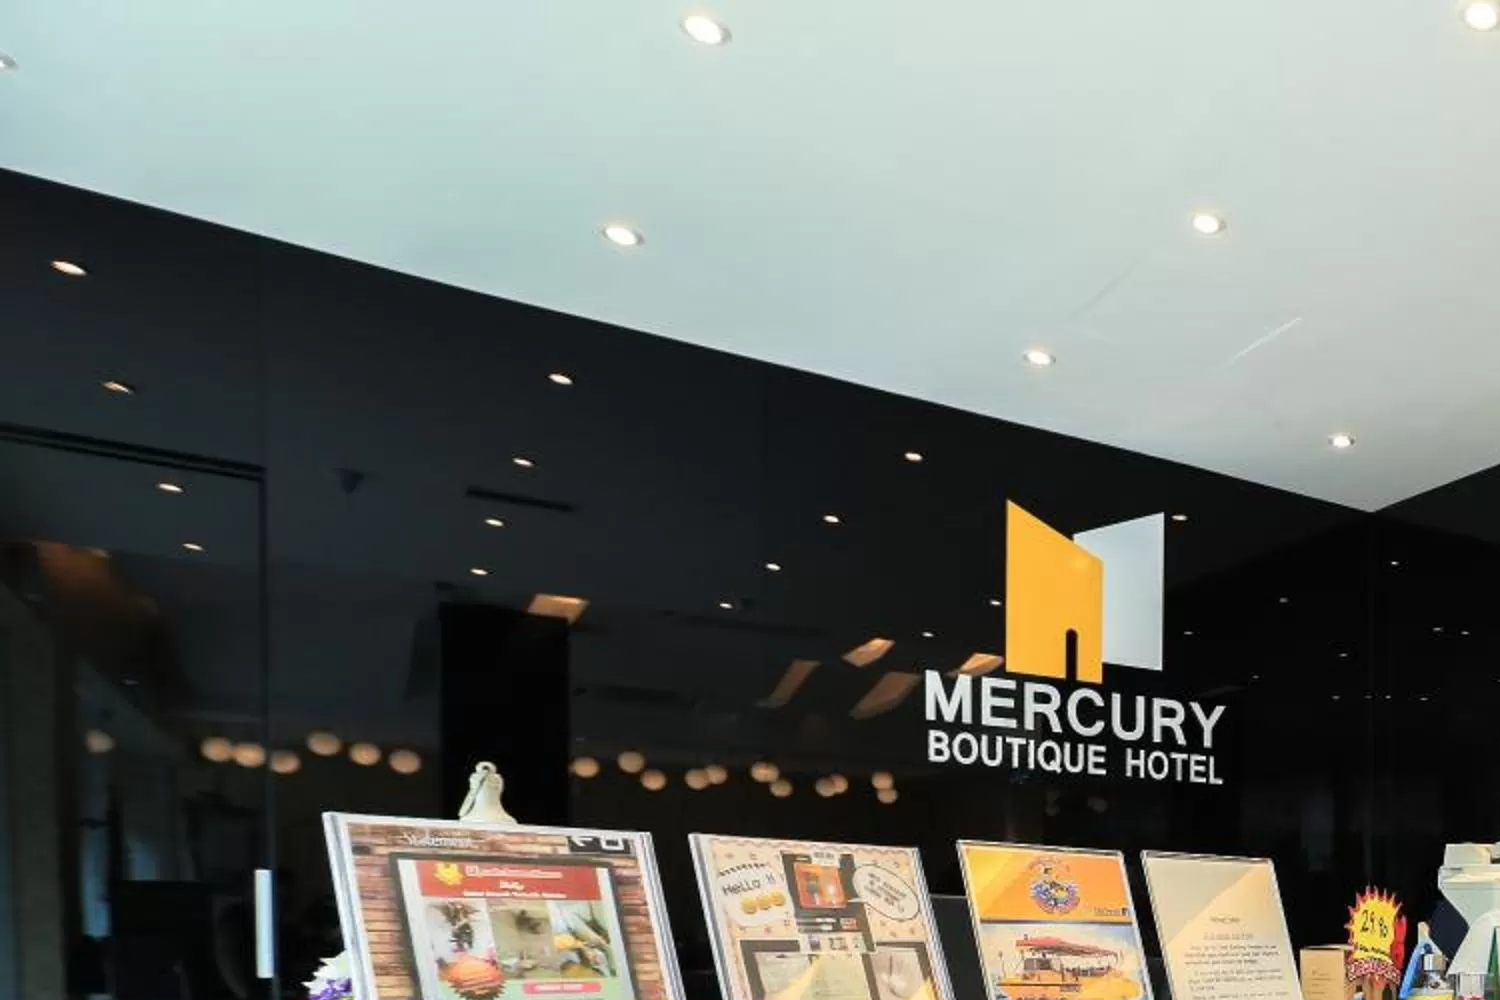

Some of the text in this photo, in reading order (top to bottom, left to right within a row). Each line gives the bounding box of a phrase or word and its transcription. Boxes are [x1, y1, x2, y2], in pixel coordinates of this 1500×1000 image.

[925, 669, 1226, 749] MERCURY
[927, 730, 1224, 785] BOUTIQUE HOTEL
[721, 879, 761, 897] Hello
